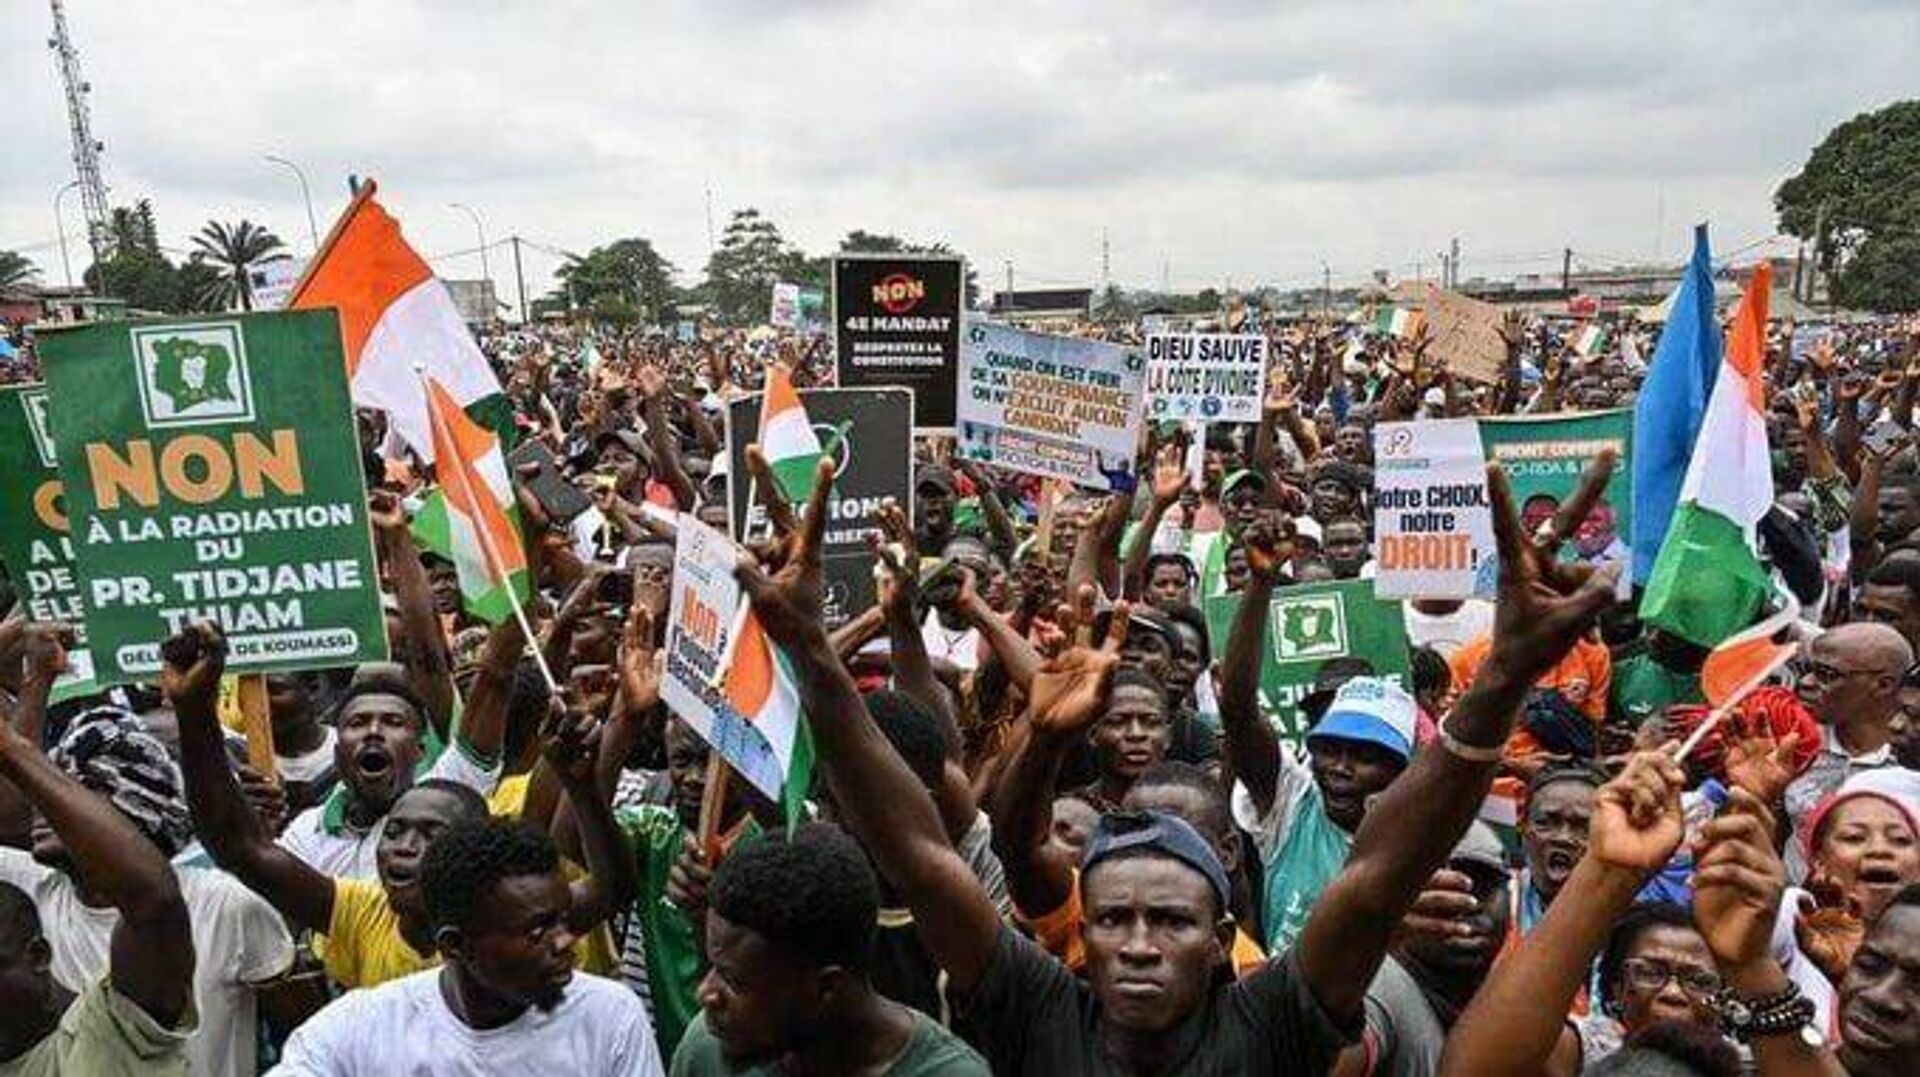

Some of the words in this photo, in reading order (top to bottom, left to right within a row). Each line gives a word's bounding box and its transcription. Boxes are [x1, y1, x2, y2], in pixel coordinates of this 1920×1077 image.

[872, 280, 924, 303] NON
[846, 317, 869, 331] 4E
[873, 317, 951, 331] MANDAT
[1150, 336, 1194, 360] DIEU
[1199, 338, 1261, 363] SAUVE
[985, 351, 1033, 371] QUAND
[1035, 361, 1056, 376] ON
[1060, 365, 1086, 381] EST
[1089, 370, 1121, 388] FIER
[1148, 367, 1163, 393] LA
[1205, 369, 1258, 396] D'IVOIRE
[970, 367, 988, 382] DE
[992, 370, 1008, 386] SA
[1011, 373, 1132, 409] GOUVERNANCE
[973, 386, 991, 401] ON
[1071, 404, 1127, 427] AUCUN
[85, 429, 304, 510] NON
[88, 515, 111, 544] À
[119, 518, 164, 543] LA
[171, 503, 353, 538] RADIATION
[1401, 510, 1455, 532] notre
[196, 537, 244, 562] DU
[91, 576, 165, 608] PR.
[173, 559, 362, 600] TIDJANE
[159, 599, 304, 636] THIAM
[235, 641, 258, 656] DE
[264, 633, 353, 653] KOUMASSI
